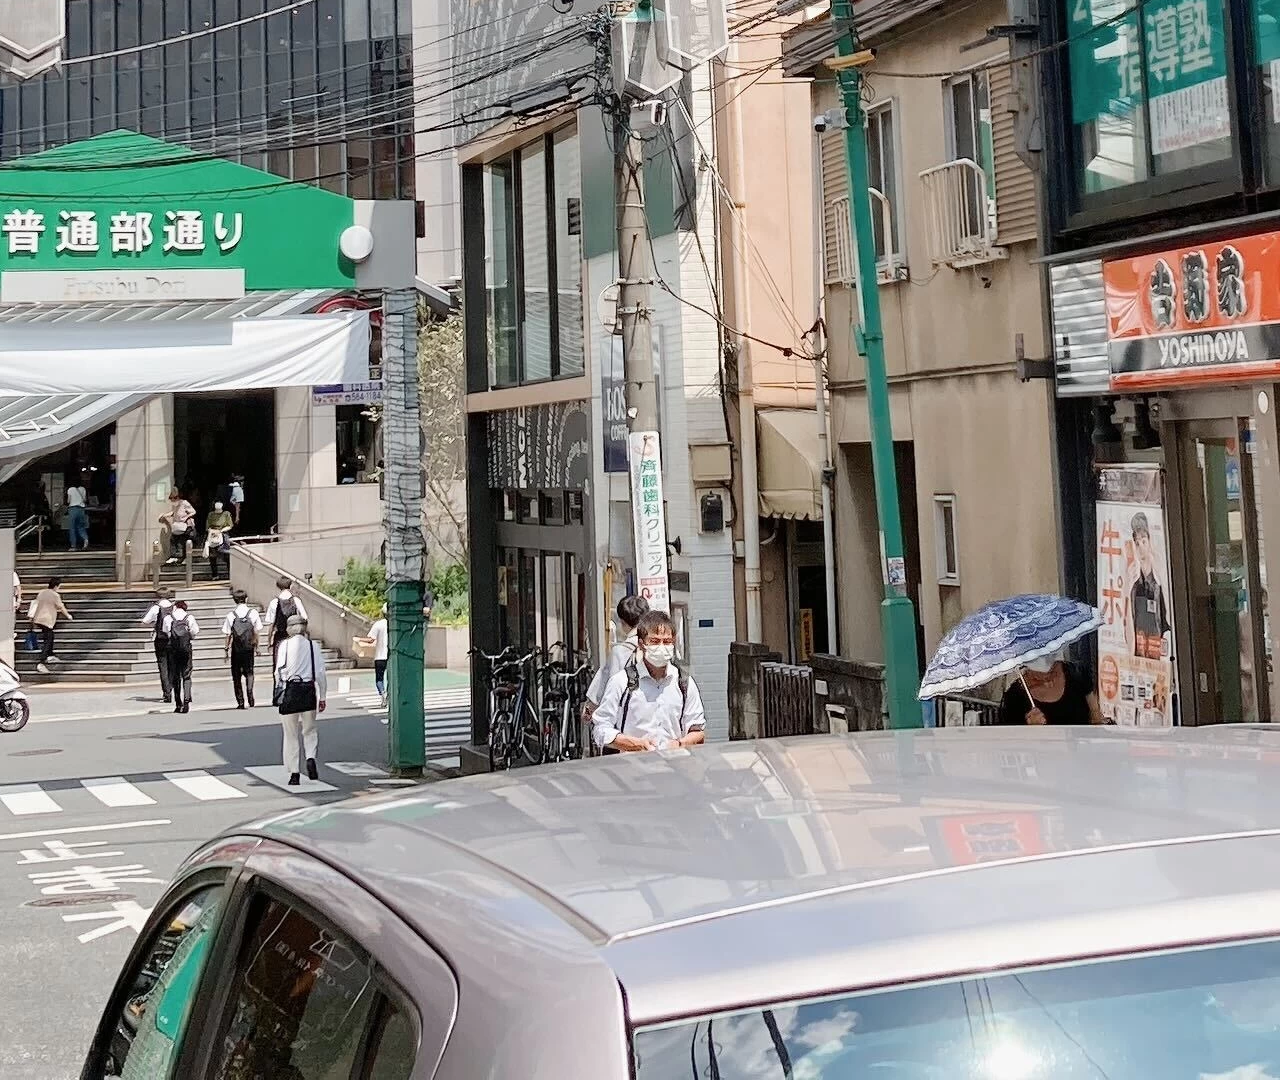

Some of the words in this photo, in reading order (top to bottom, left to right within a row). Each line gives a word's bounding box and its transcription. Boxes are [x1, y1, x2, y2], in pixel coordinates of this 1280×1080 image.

[1, 208, 243, 254] 普通部通り
